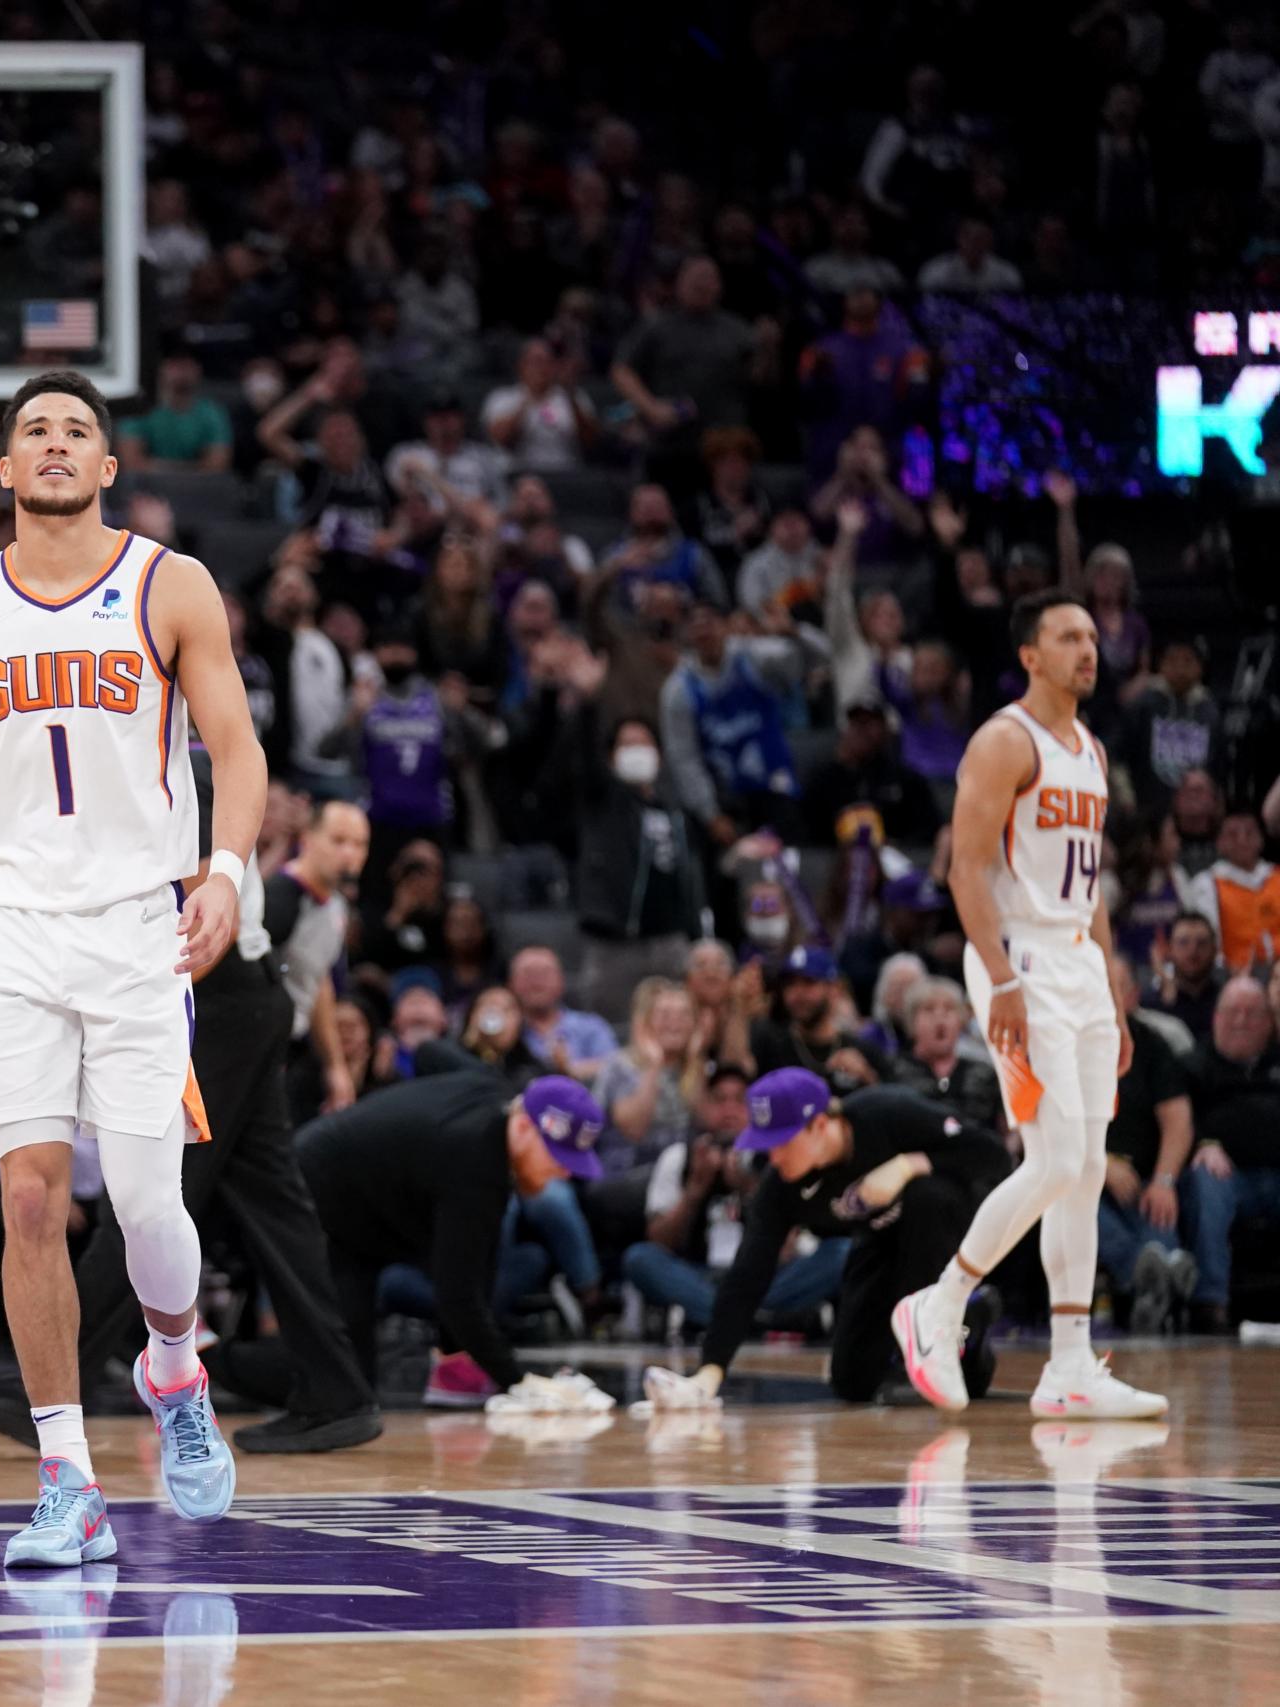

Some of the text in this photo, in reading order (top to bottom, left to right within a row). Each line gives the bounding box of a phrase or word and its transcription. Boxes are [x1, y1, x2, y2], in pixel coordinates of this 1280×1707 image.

[92, 610, 129, 621] PayPal
[45, 724, 76, 816] 1
[1060, 838, 1098, 902] 14
